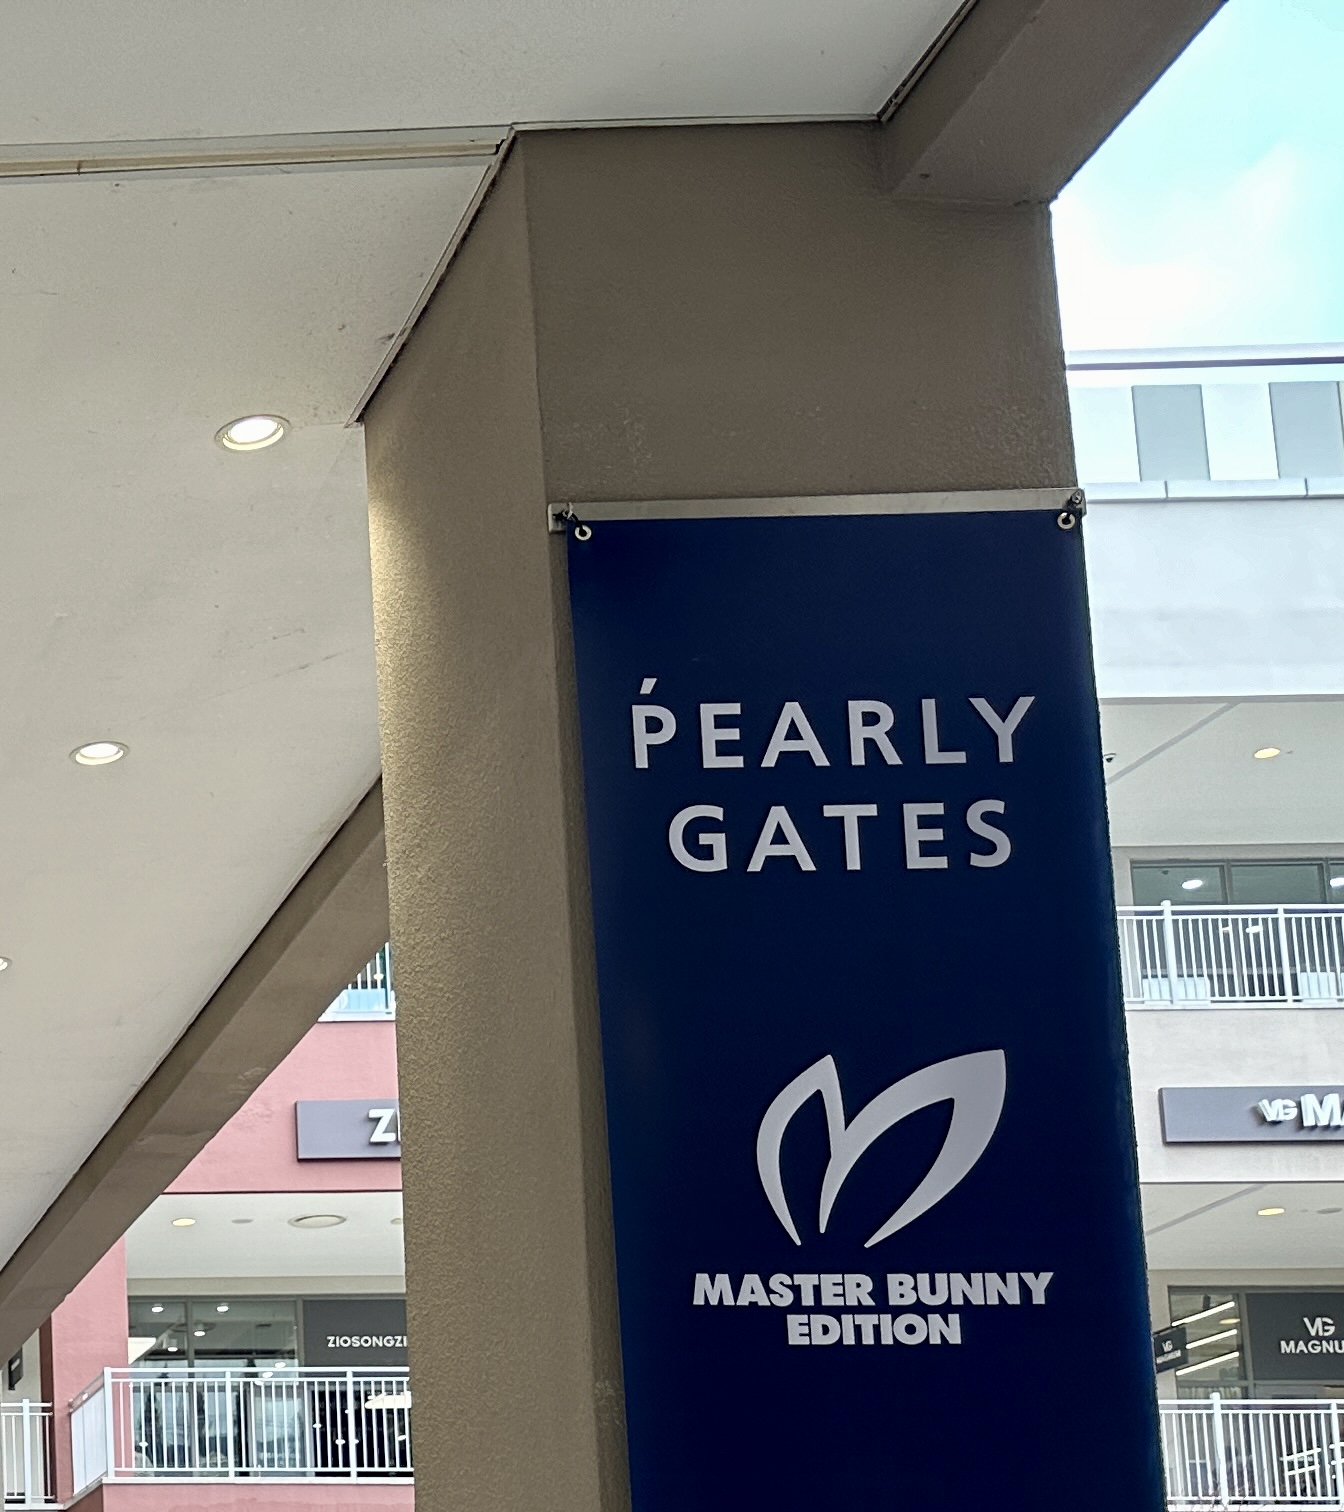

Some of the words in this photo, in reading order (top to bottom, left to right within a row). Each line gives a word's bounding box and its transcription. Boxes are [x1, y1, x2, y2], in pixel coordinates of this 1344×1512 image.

[669, 799, 1012, 873] GATES
[693, 1273, 875, 1307] MASTER
[887, 1272, 1054, 1305] BUNNY
[327, 1336, 407, 1347] ZIOSONGZI
[787, 1313, 962, 1346] EDITION
